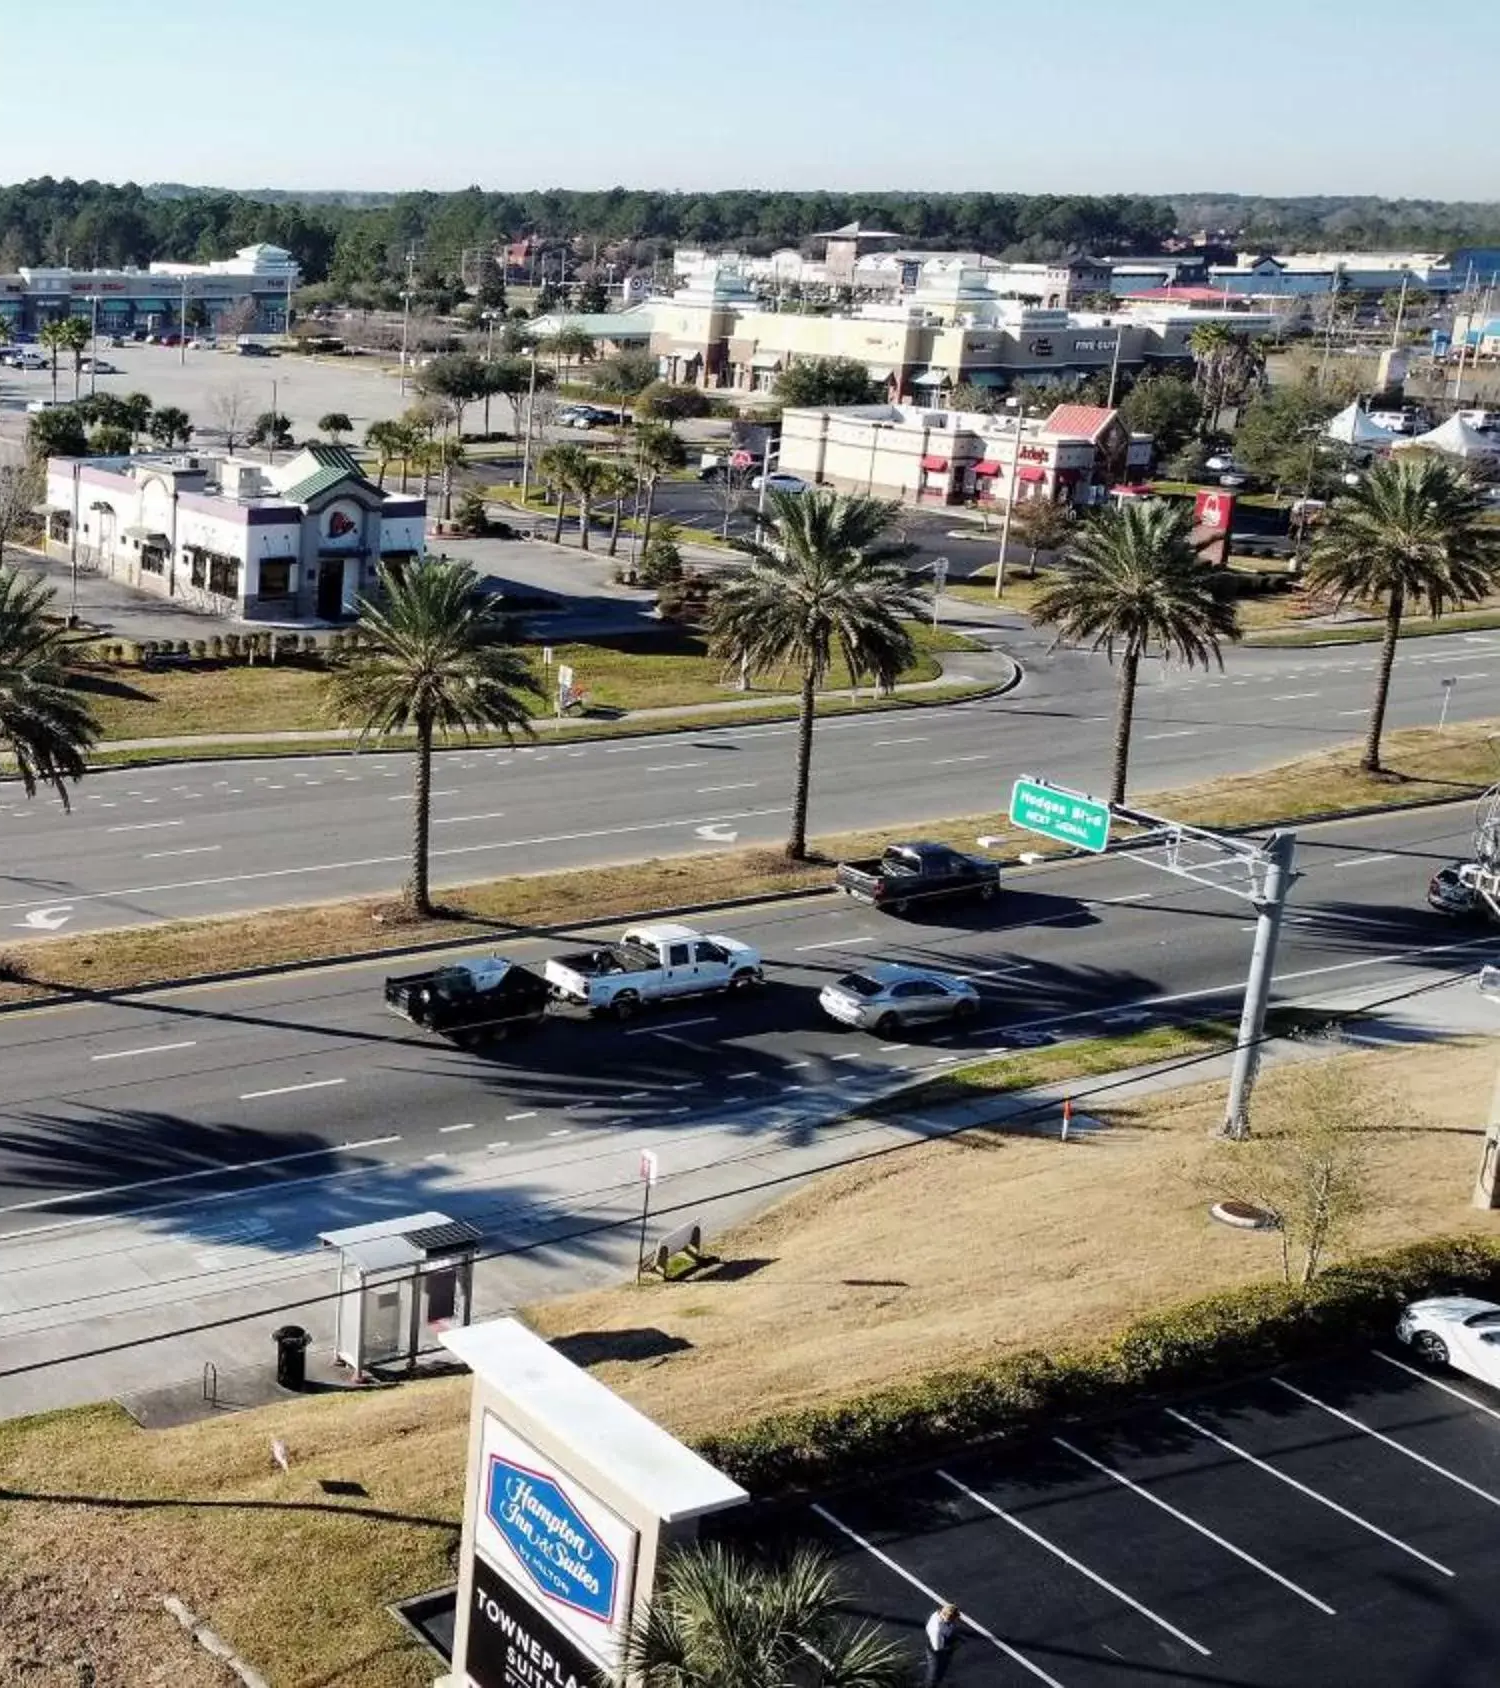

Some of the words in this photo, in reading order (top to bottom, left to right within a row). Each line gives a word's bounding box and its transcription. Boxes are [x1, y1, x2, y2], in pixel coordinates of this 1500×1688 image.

[1019, 790, 1067, 815] Hodges
[1071, 806, 1103, 827] Blvd
[500, 1499, 541, 1545] Inn
[550, 1541, 599, 1595] Suites
[505, 1477, 593, 1561] Hampton
[475, 1587, 584, 1688] TOWNEPLA
